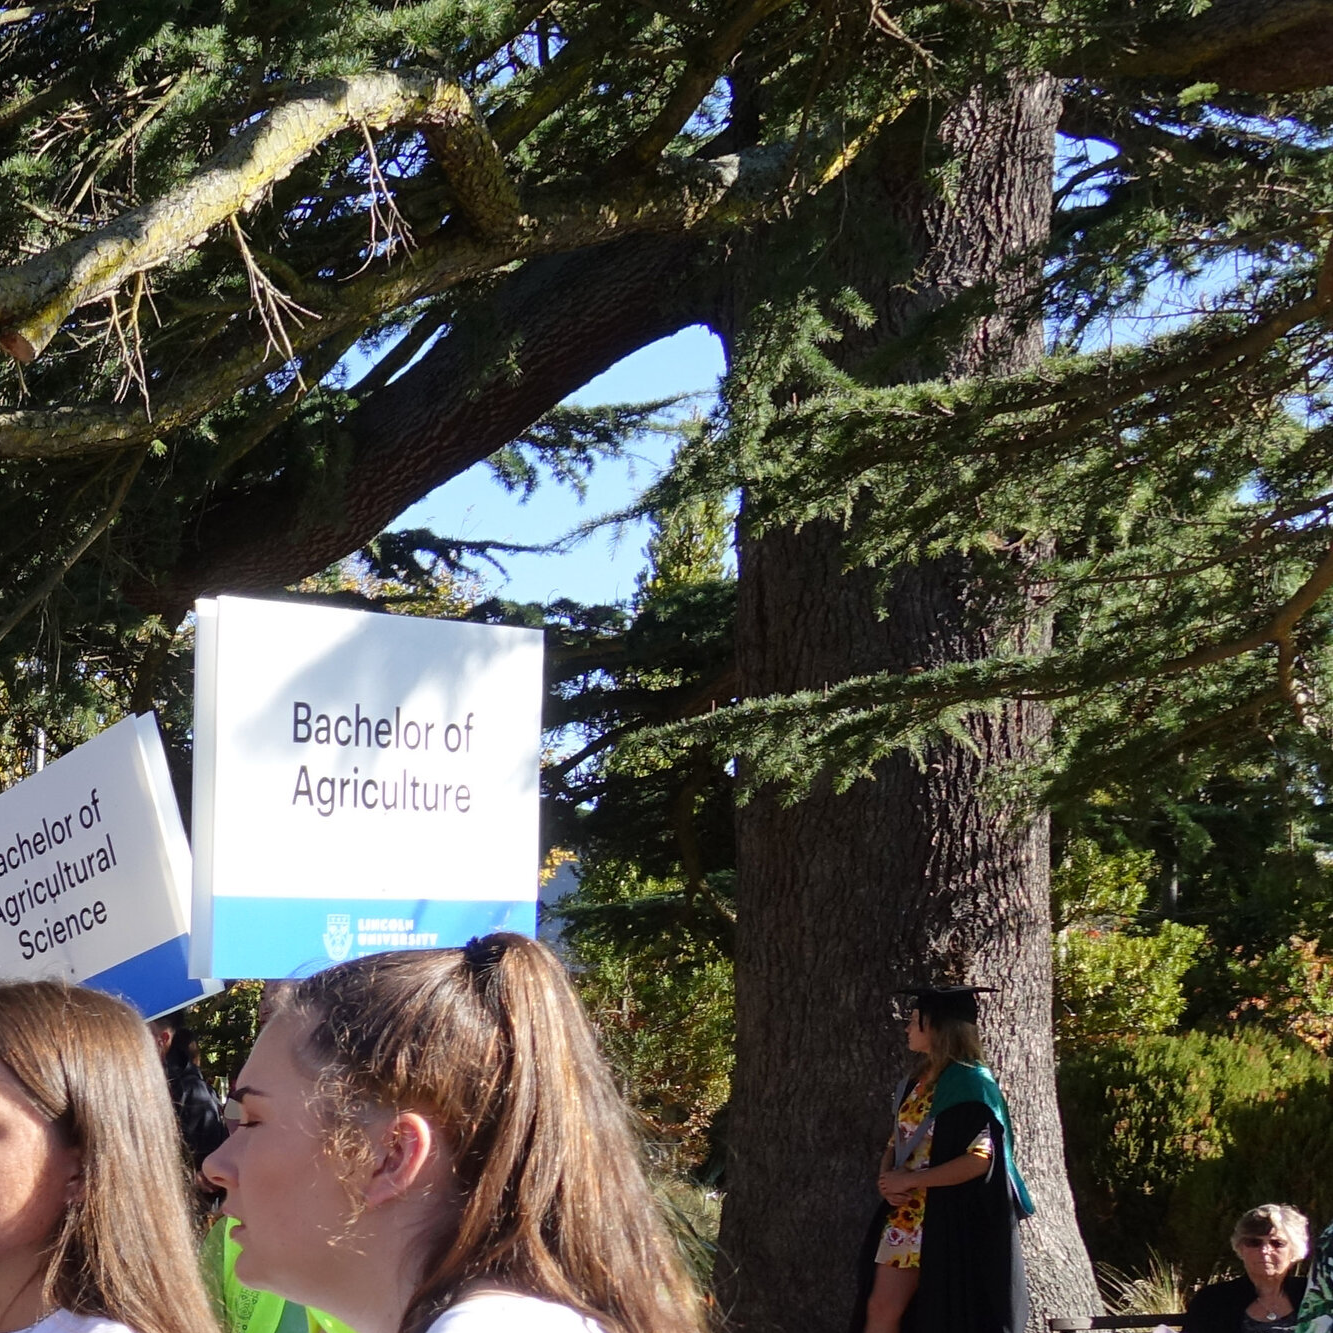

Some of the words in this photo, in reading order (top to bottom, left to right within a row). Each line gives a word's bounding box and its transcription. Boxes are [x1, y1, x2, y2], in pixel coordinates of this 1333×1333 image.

[292, 701, 435, 750] Bachelor
[444, 711, 475, 753] of
[78, 787, 102, 830] of
[292, 764, 471, 818] Agriculture
[18, 899, 108, 961] Science
[357, 918, 415, 932] LINCOLN
[357, 933, 439, 946] UNIVERSITY
